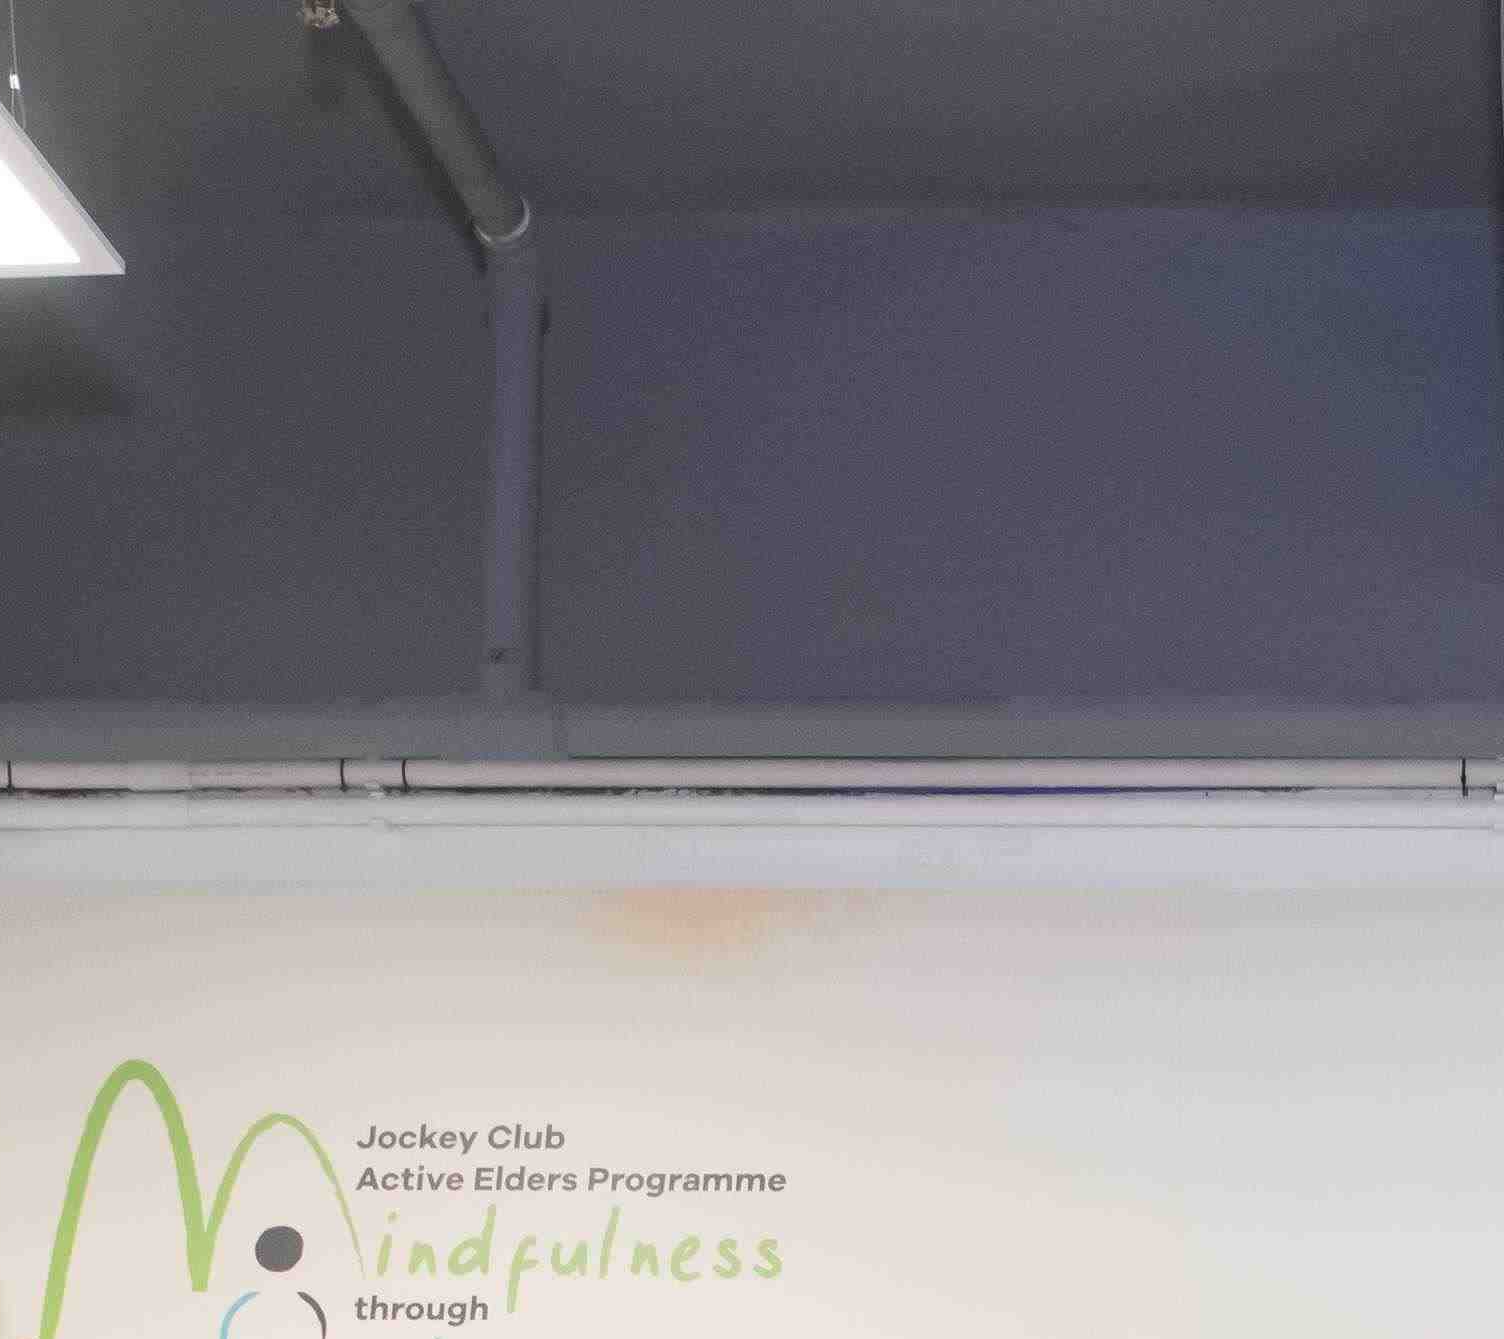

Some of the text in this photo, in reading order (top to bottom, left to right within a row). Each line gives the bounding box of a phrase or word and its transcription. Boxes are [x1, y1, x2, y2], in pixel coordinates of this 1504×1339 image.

[356, 1122, 566, 1155] Jockey Club
[355, 1165, 788, 1198] Active Elders Programme
[355, 1294, 490, 1327] through
